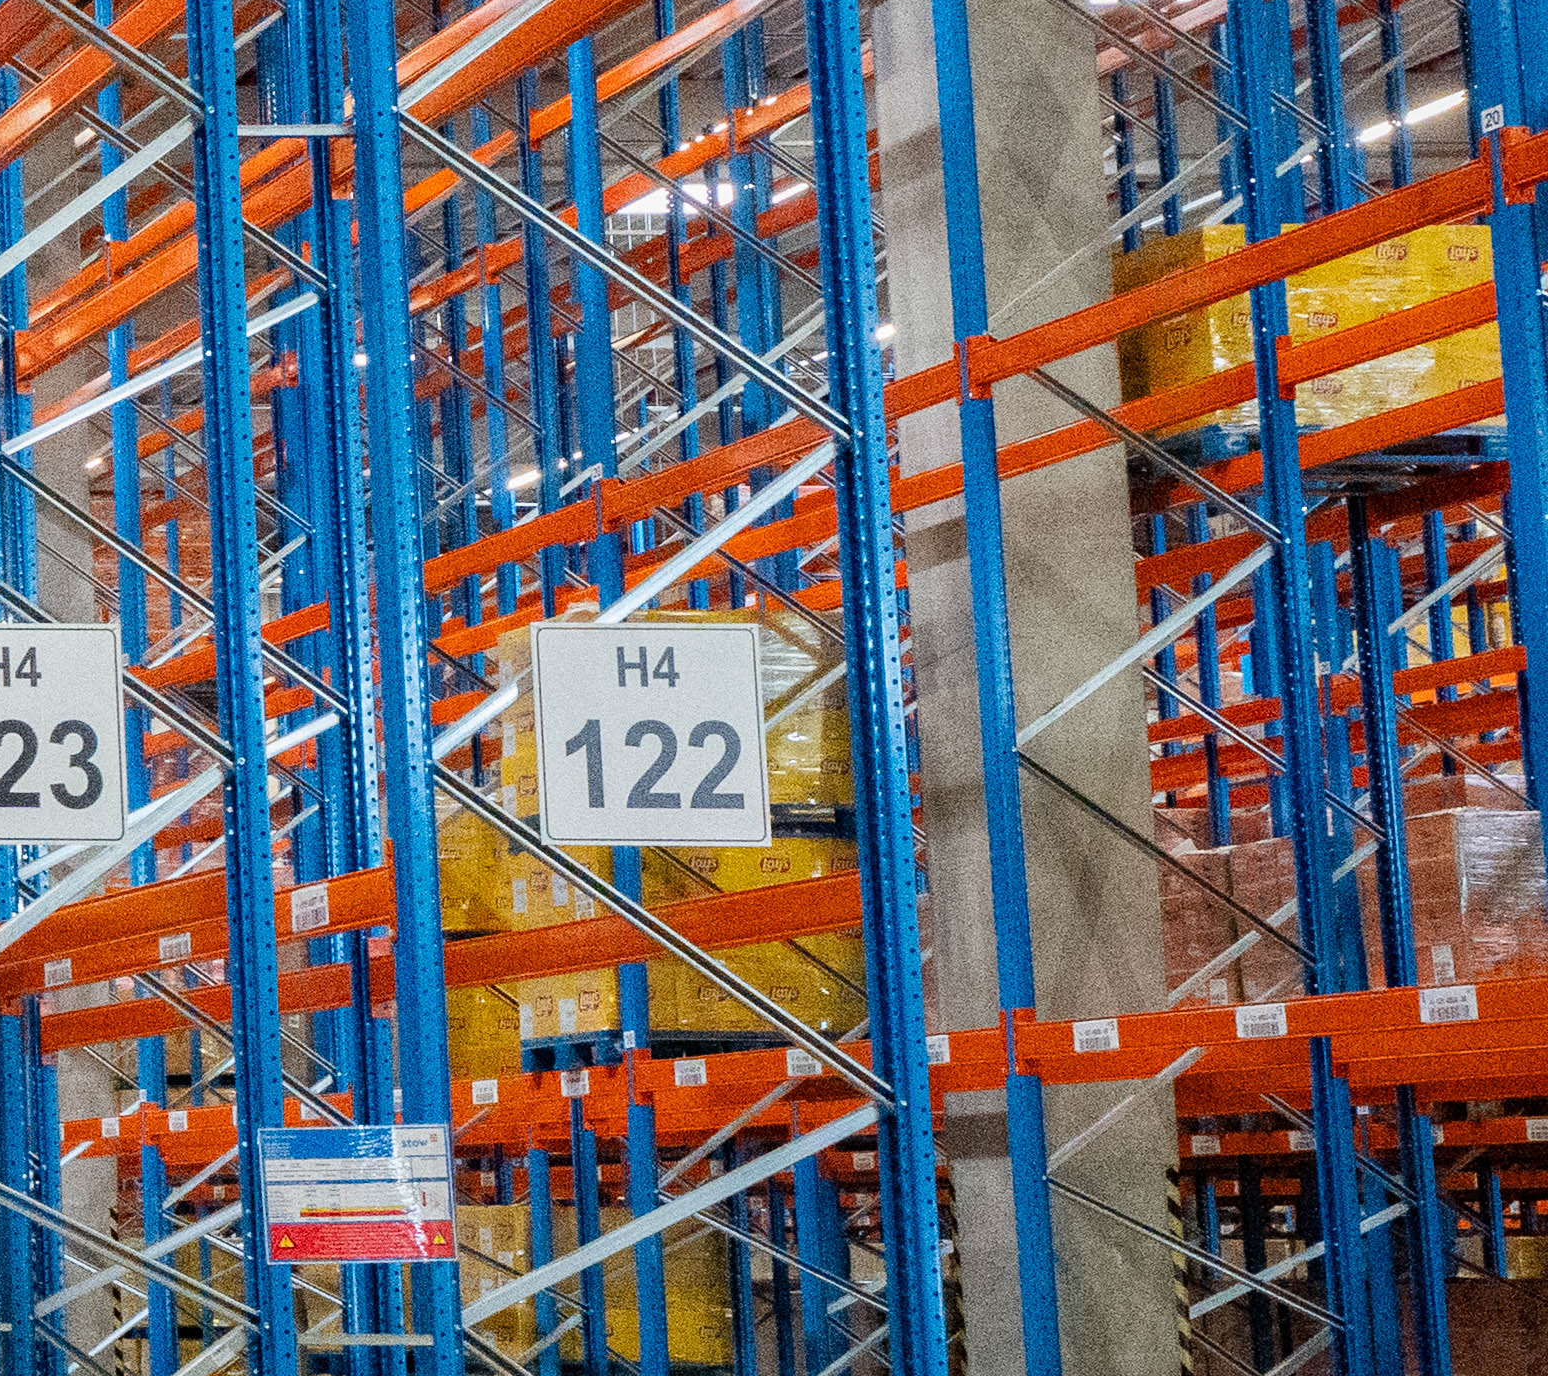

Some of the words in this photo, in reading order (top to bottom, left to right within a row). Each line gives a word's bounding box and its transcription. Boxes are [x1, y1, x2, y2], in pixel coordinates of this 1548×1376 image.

[1485, 112, 1501, 128] 20
[617, 646, 679, 687] H4
[566, 719, 744, 809] 122
